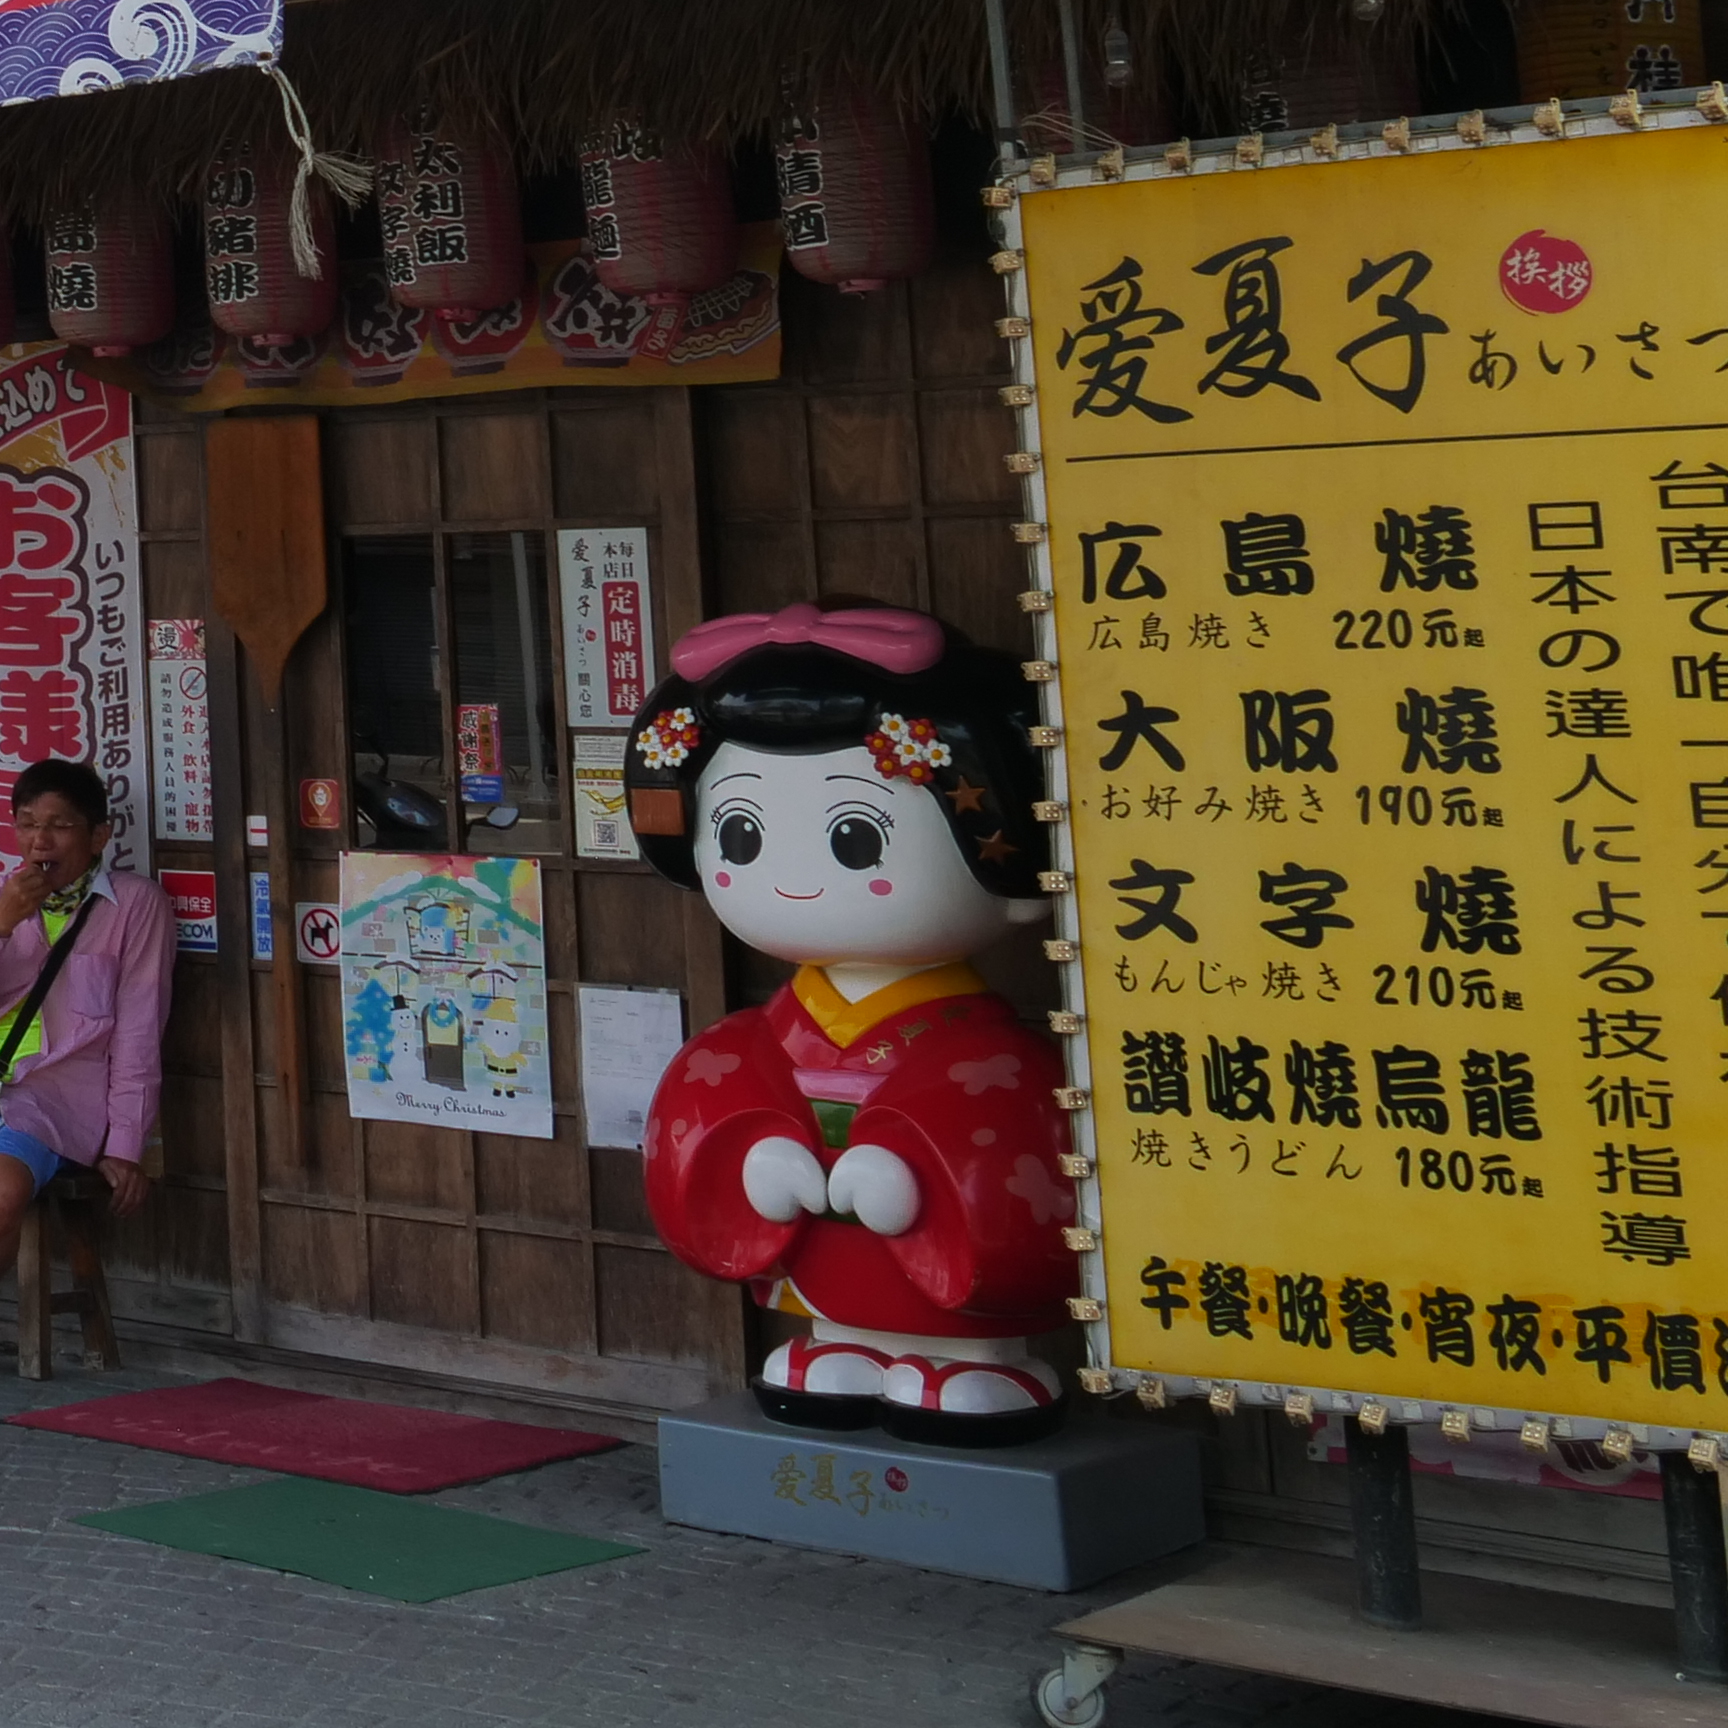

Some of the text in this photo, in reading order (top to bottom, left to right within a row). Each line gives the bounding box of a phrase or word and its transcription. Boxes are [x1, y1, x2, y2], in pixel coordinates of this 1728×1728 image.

[777, 99, 830, 253] 本清酒
[607, 586, 641, 714] 定時消毒
[1086, 609, 1486, 654] 広島焼き 220元起
[1096, 685, 1502, 774] 大阪燒
[1354, 785, 1505, 829] 190元起
[1109, 858, 1523, 956] 文字燒
[1528, 501, 1692, 1268] 日本の達人による技術指導
[177, 923, 214, 939] ECOM
[1115, 959, 1525, 1012] もんじゃ焼き 210元起
[395, 1090, 508, 1119] Merry Christmas
[1130, 1128, 1544, 1200] 焼きうどん 180元起
